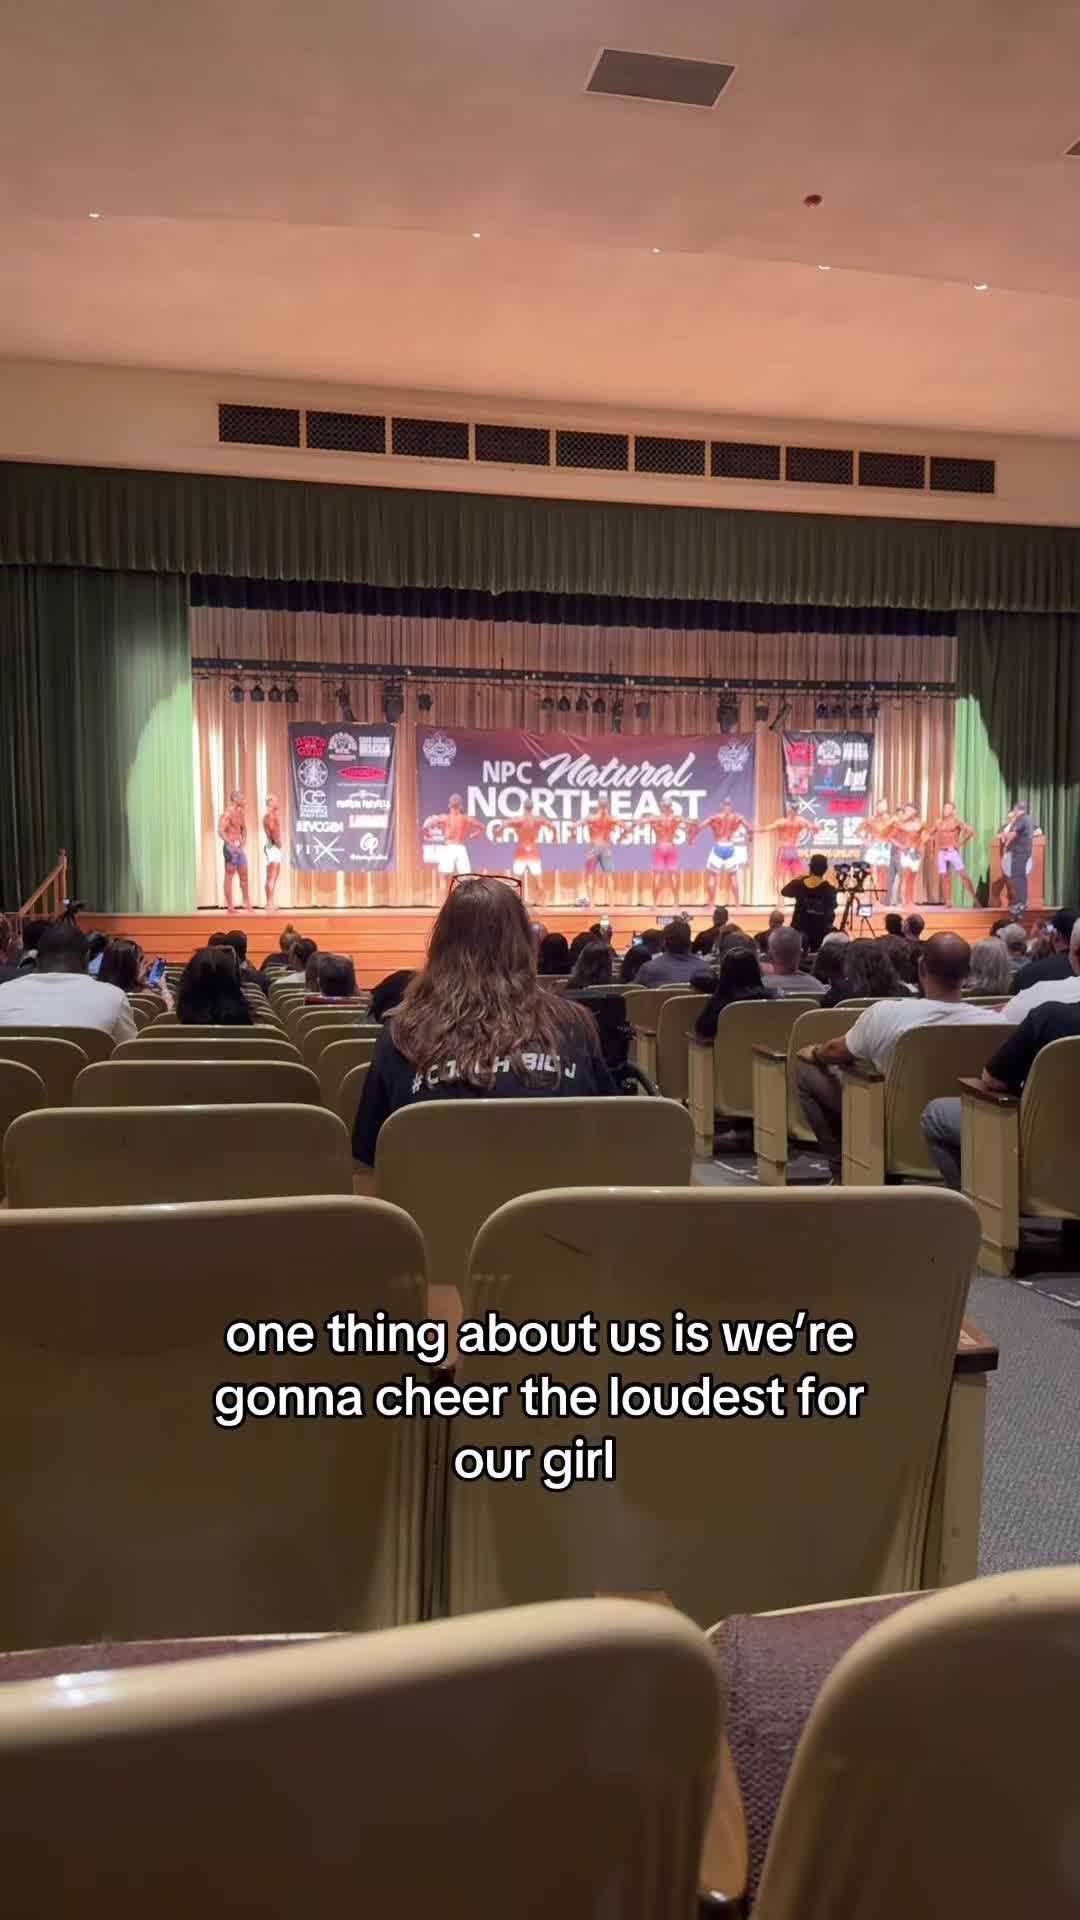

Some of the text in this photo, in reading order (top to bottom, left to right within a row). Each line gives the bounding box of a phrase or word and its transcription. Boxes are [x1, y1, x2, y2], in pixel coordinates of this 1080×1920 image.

[482, 760, 533, 784] NPC
[539, 752, 696, 787] Natural
[467, 786, 707, 820] NORTHEAST
[564, 1062, 576, 1079] J
